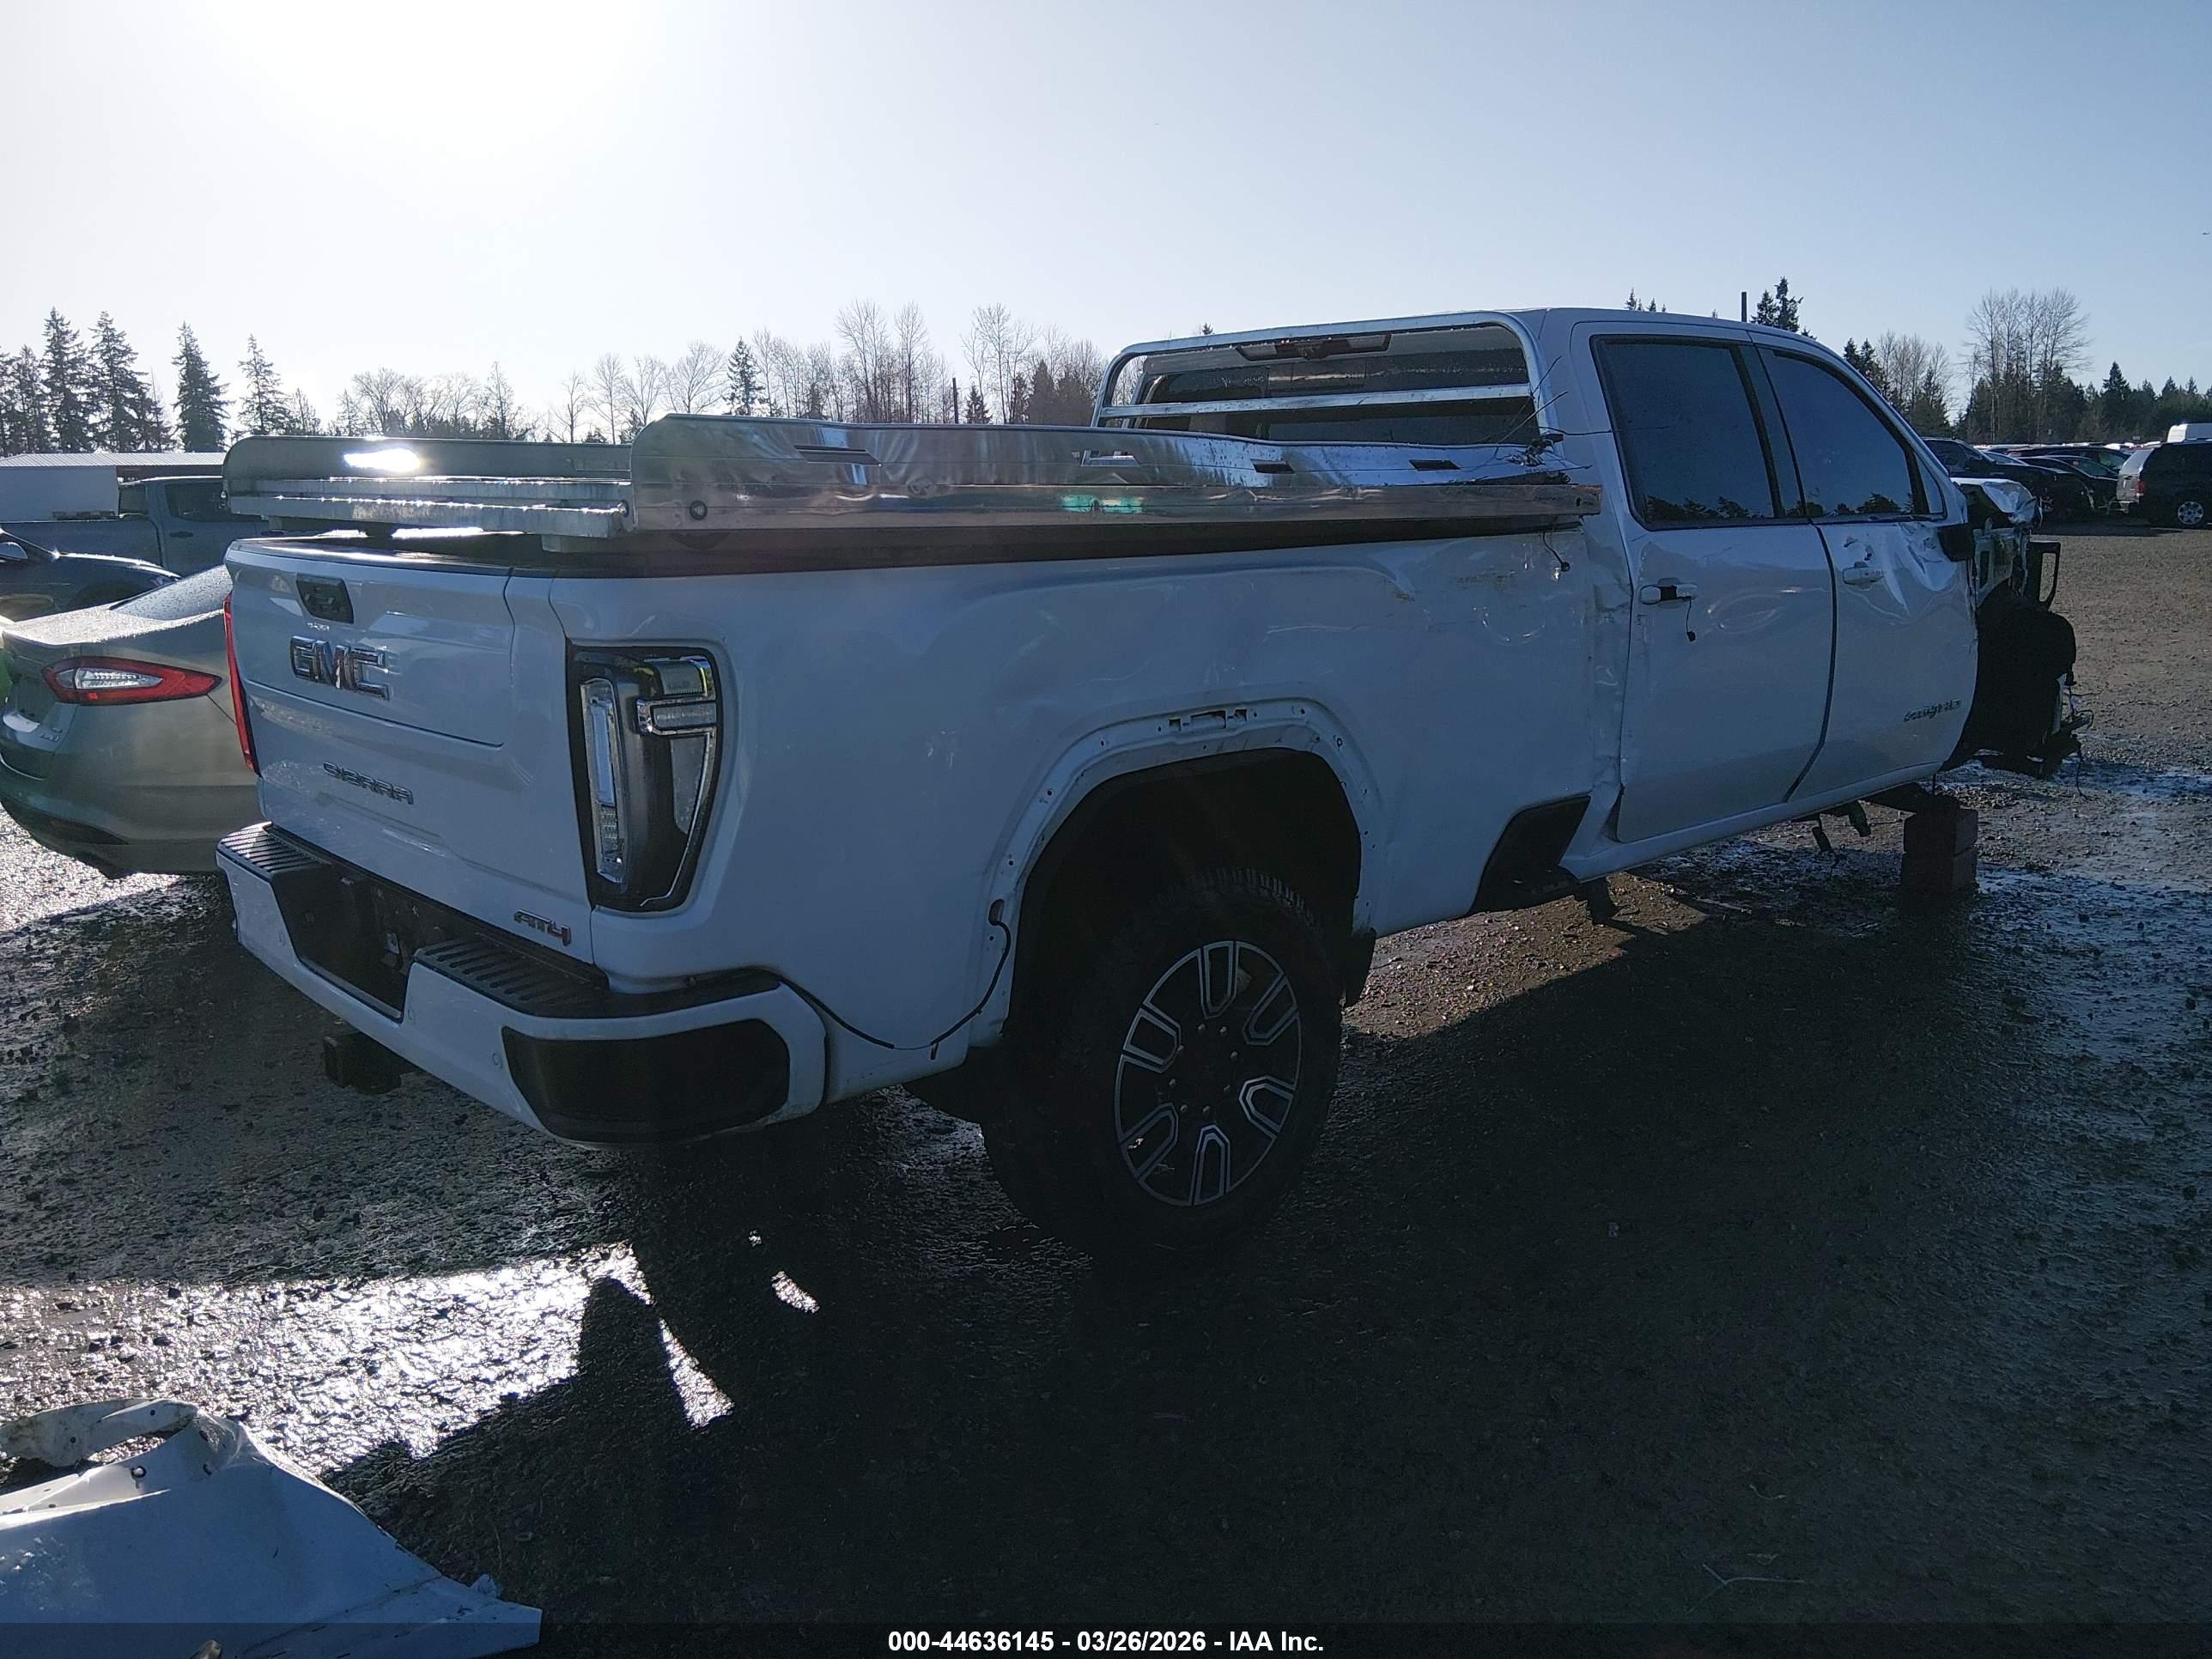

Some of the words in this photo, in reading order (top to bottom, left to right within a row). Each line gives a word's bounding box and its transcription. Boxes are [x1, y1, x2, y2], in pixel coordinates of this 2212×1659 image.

[290, 635, 390, 701] GMC
[323, 762, 414, 805] SIERRA
[514, 908, 572, 947] AT4
